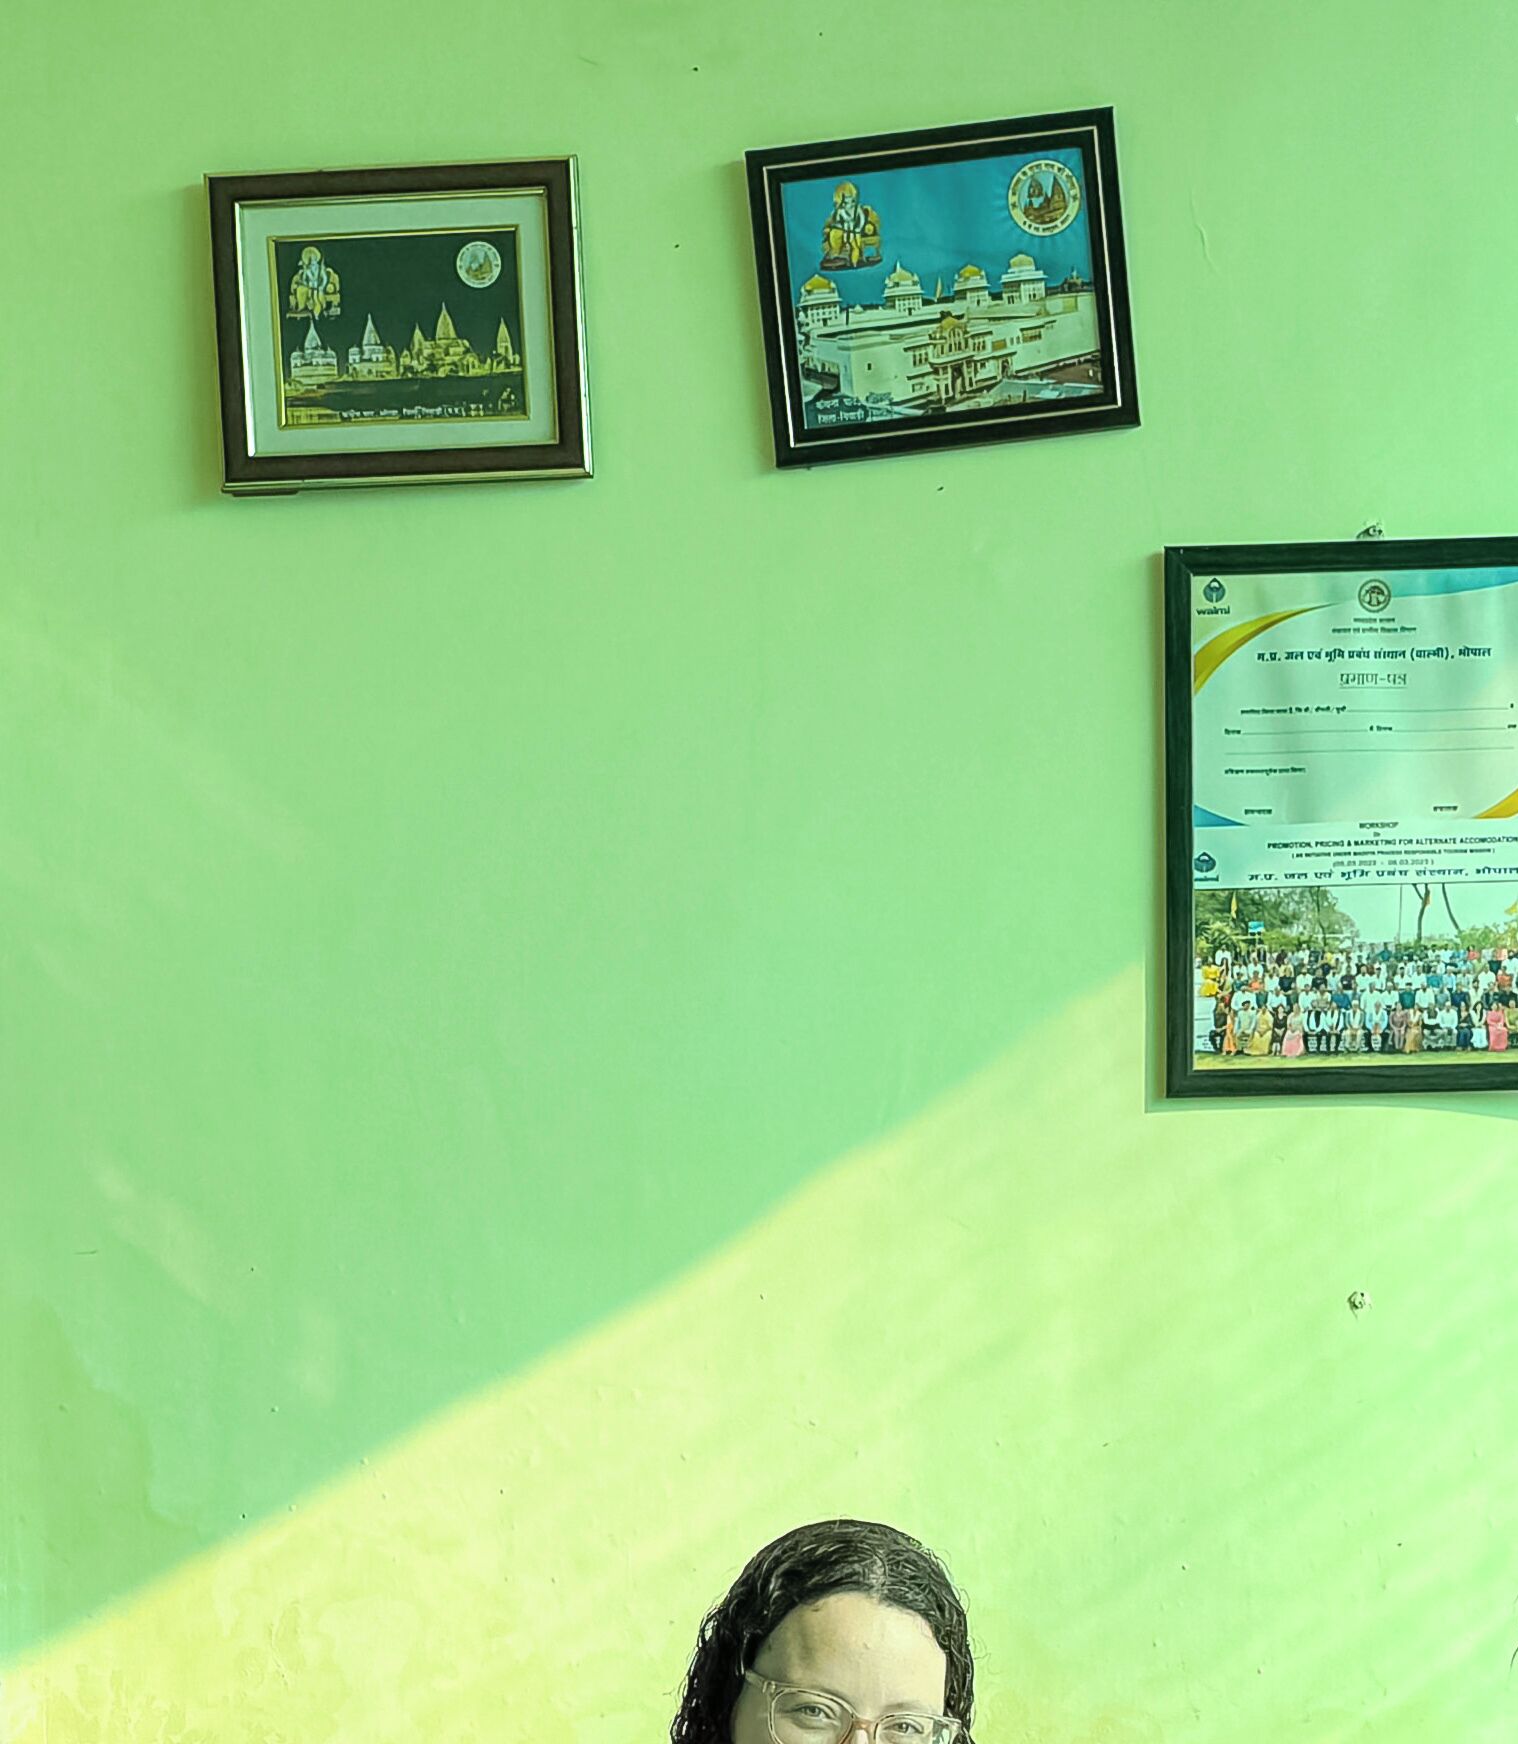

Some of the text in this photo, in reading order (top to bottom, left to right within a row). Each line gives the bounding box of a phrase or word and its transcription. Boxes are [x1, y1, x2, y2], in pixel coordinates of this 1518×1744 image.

[1196, 606, 1231, 616] walmi
[1458, 645, 1492, 657] भोपाल
[1315, 840, 1345, 848] PRICING
